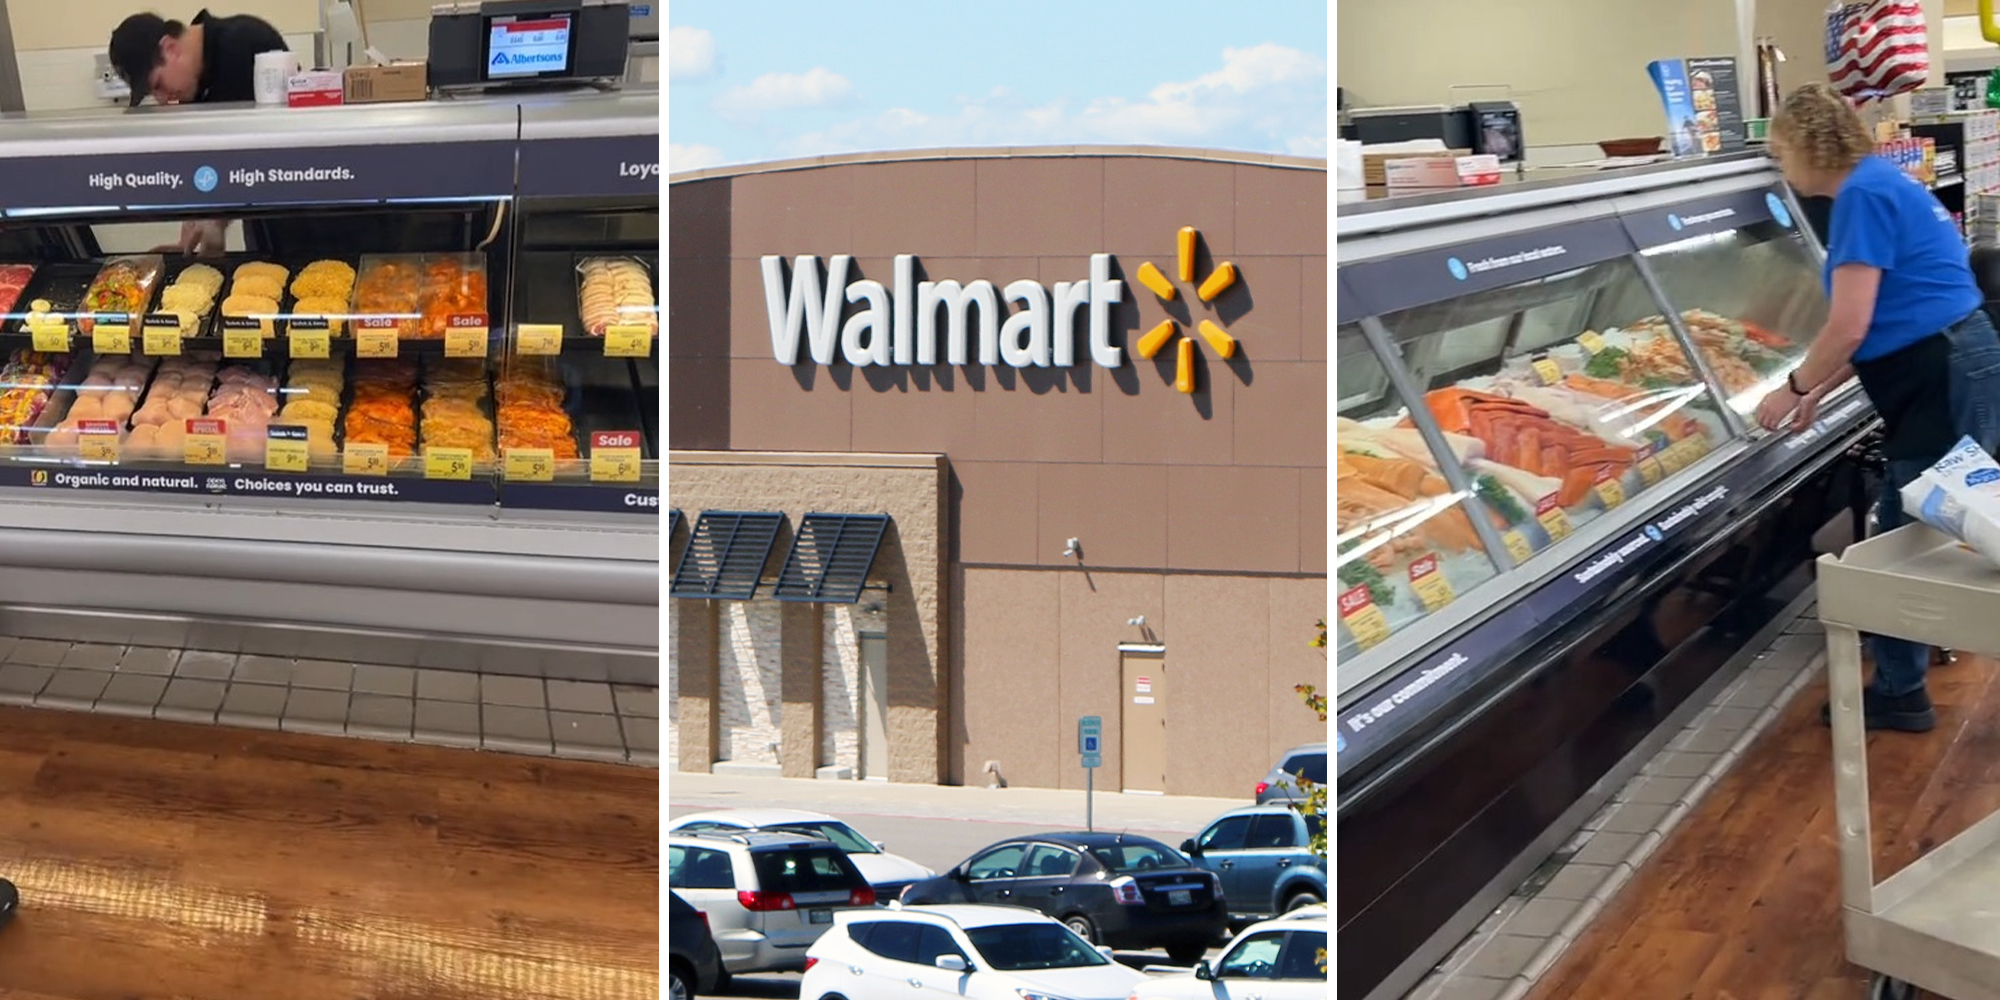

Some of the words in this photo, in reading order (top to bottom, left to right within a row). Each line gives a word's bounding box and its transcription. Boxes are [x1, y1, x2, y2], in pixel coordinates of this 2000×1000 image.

[510, 52, 562, 64] Albertsons
[89, 173, 122, 190] High
[125, 172, 183, 188] Quality.
[229, 169, 264, 186] High
[268, 166, 355, 183] Standards.
[761, 253, 1122, 368] Walmart
[363, 317, 392, 327] Sale
[452, 316, 482, 327] Sale
[598, 434, 632, 446] Sale
[55, 472, 109, 488] Organic
[112, 473, 139, 486] and
[142, 474, 198, 489] natural.
[234, 477, 292, 491] Choices
[295, 481, 323, 495] you
[325, 483, 353, 493] can
[356, 482, 399, 495] trust.
[1346, 712, 1375, 733] It's
[1369, 698, 1396, 719] our
